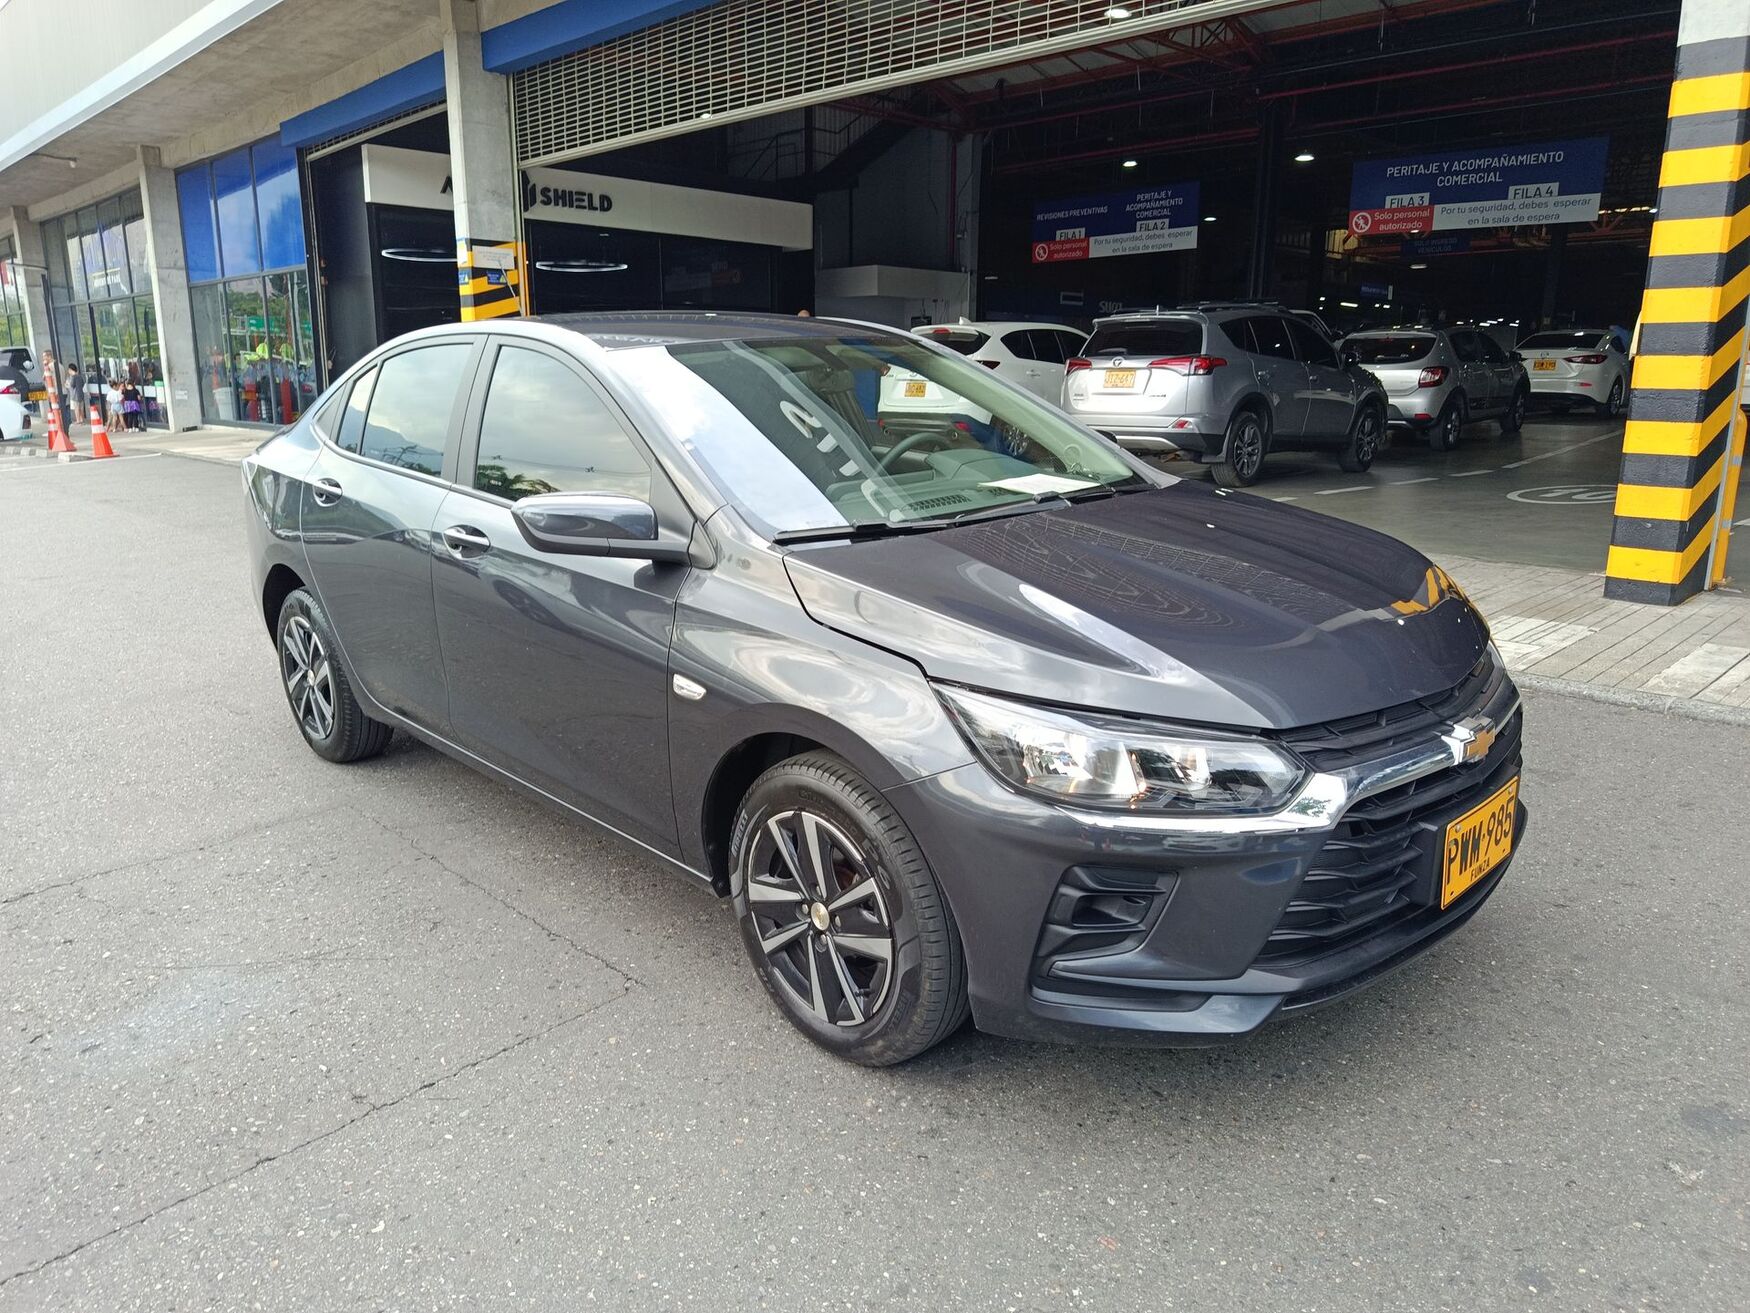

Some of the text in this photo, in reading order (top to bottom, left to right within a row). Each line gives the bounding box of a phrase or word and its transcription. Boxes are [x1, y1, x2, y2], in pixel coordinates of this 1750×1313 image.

[1386, 151, 1564, 177] PERITAJE Y ACOMPAÑAMIENTO
[1437, 171, 1503, 187] COMERCIAL
[540, 186, 613, 212] SHIELD
[1136, 189, 1173, 201] PERITAJE Y
[1513, 185, 1553, 200] FILA 4
[1125, 197, 1183, 211] ACOMPAÑAMIENTO
[1389, 195, 1425, 208] FILA 3
[1440, 198, 1592, 215] Por tu seguridad, debes esperar
[1036, 205, 1108, 221] REVISIONES PREVENTIVAS
[1135, 208, 1172, 219] COMERCIAL
[1374, 209, 1430, 220] Solo personal
[1467, 213, 1560, 226] en la sala de espera
[1139, 221, 1166, 232] FILA 2
[1379, 220, 1423, 231] autorizado
[1059, 229, 1077, 240] FILA
[1144, 231, 1165, 241] debes
[1167, 229, 1193, 240] esperar
